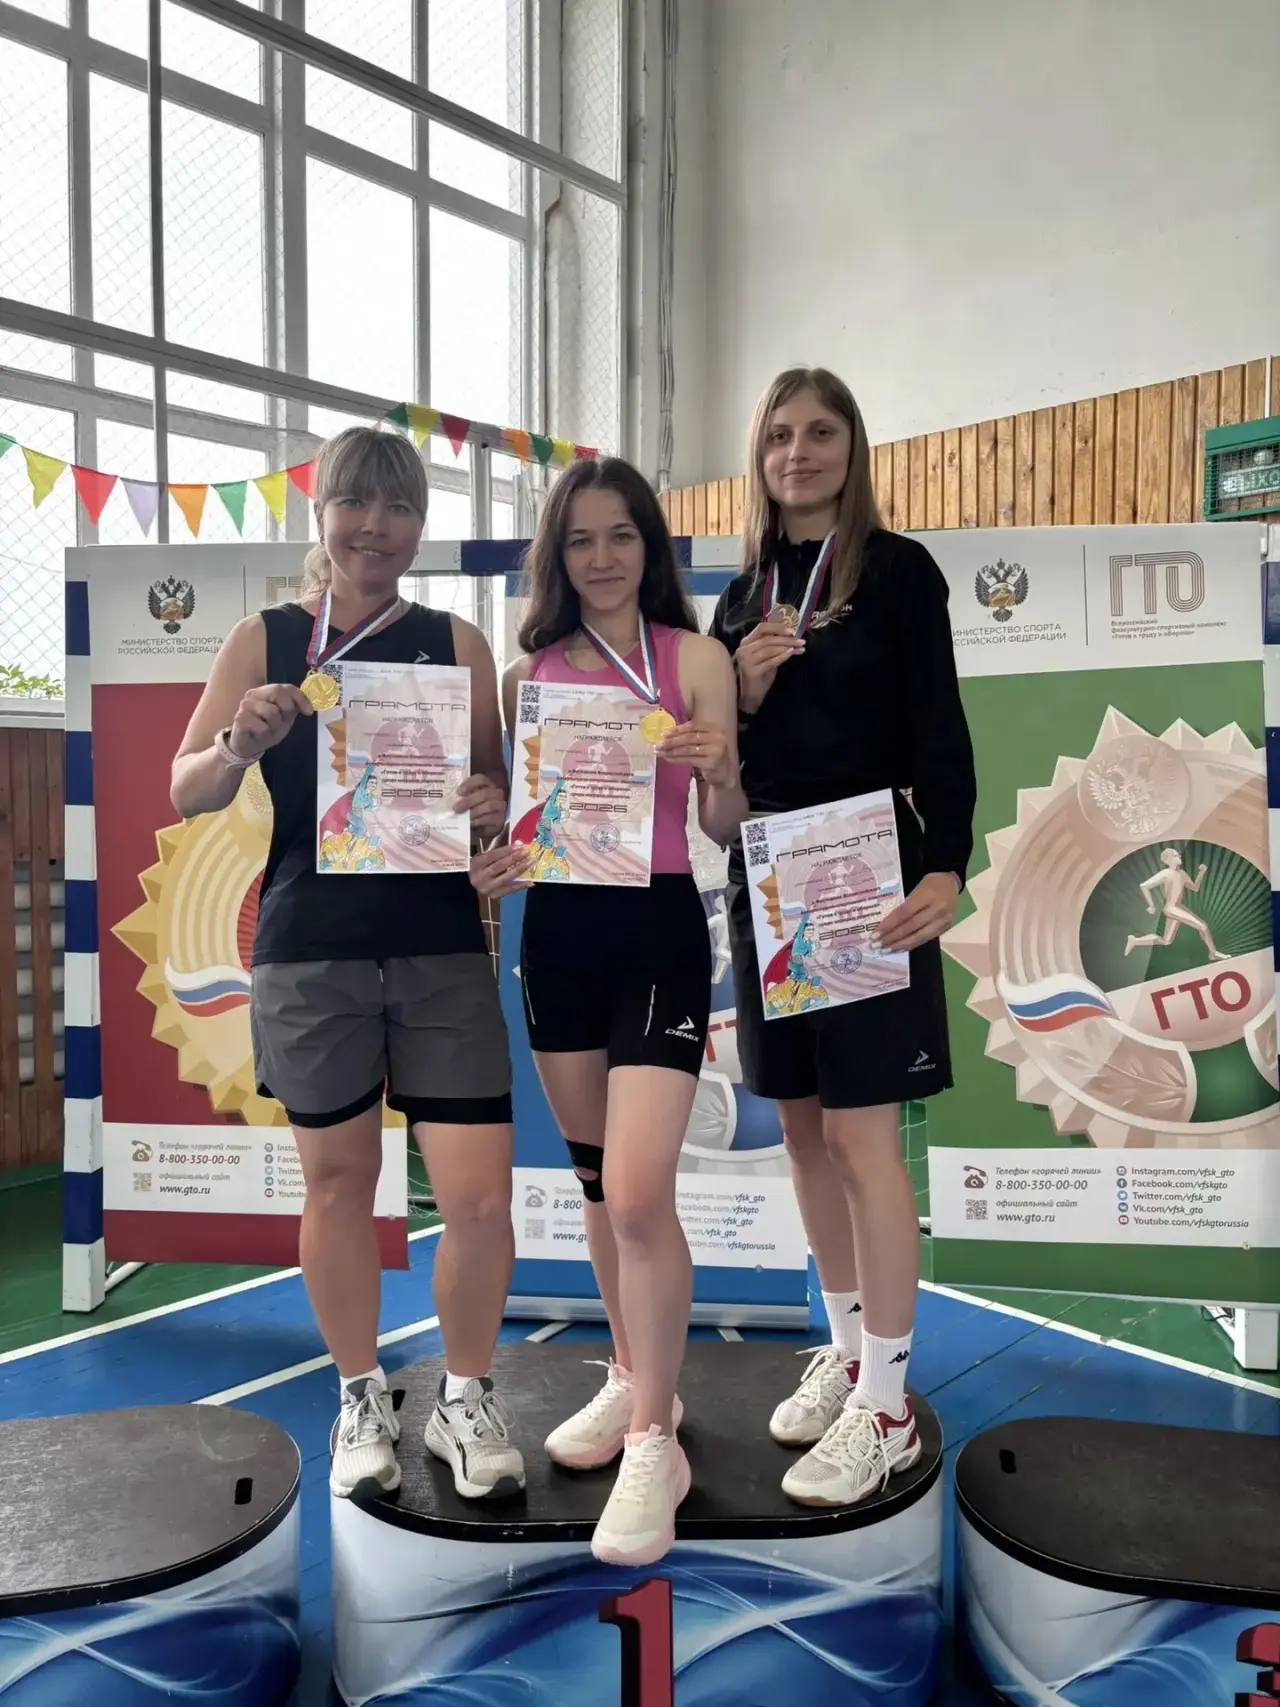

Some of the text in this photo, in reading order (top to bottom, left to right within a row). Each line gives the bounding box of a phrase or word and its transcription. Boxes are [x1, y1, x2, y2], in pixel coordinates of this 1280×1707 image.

[1223, 469, 1280, 493] ВЫХО
[1109, 550, 1205, 616] ГТО
[952, 623, 1062, 636] ИНИСТЕРСТВО СПОРТА
[122, 637, 224, 646] МИНИСТЕРСТВО СПОРТА
[954, 632, 1067, 646] ССИЙСКОЙ ФЕДЕРАЦИИ
[118, 645, 220, 655] РОССИЙСКОЙ ФЕДЕРАЦ
[348, 699, 467, 711] ГРАМОТА
[544, 718, 640, 731] ГРАМОТ
[380, 788, 444, 798] 2026
[569, 802, 628, 813] 2026
[776, 829, 893, 863] ГРАМОТА
[1150, 971, 1252, 1031] ГТО
[665, 1027, 700, 1043] DEMIX
[907, 1062, 937, 1073] DEMIX
[277, 1143, 298, 1152] Insta
[158, 1154, 241, 1165] 8-800-350-00-00
[995, 1166, 1030, 1177] Телефон
[1031, 1167, 1069, 1177] «горячей
[1131, 1167, 1235, 1177] Instagram.com/vfsk_gto
[995, 1179, 1088, 1191] 8-800-350-00-00
[1131, 1179, 1228, 1190] Facebook.com/vfskgto
[159, 1185, 211, 1196] www.gto.ru
[1132, 1192, 1222, 1202] Twitter.com/vfsk_gto
[552, 1199, 583, 1210] 8-800-
[996, 1199, 1078, 1209] официальный сайт
[1133, 1204, 1204, 1215] Vk.com/vfsk_gto
[679, 1215, 754, 1226] witter.com/vfsk_gto
[996, 1213, 1056, 1224] www.gto.ru
[1133, 1216, 1249, 1229] Youtube.com/vfskgtorussia
[686, 1227, 737, 1238] .com/vfsk_gto
